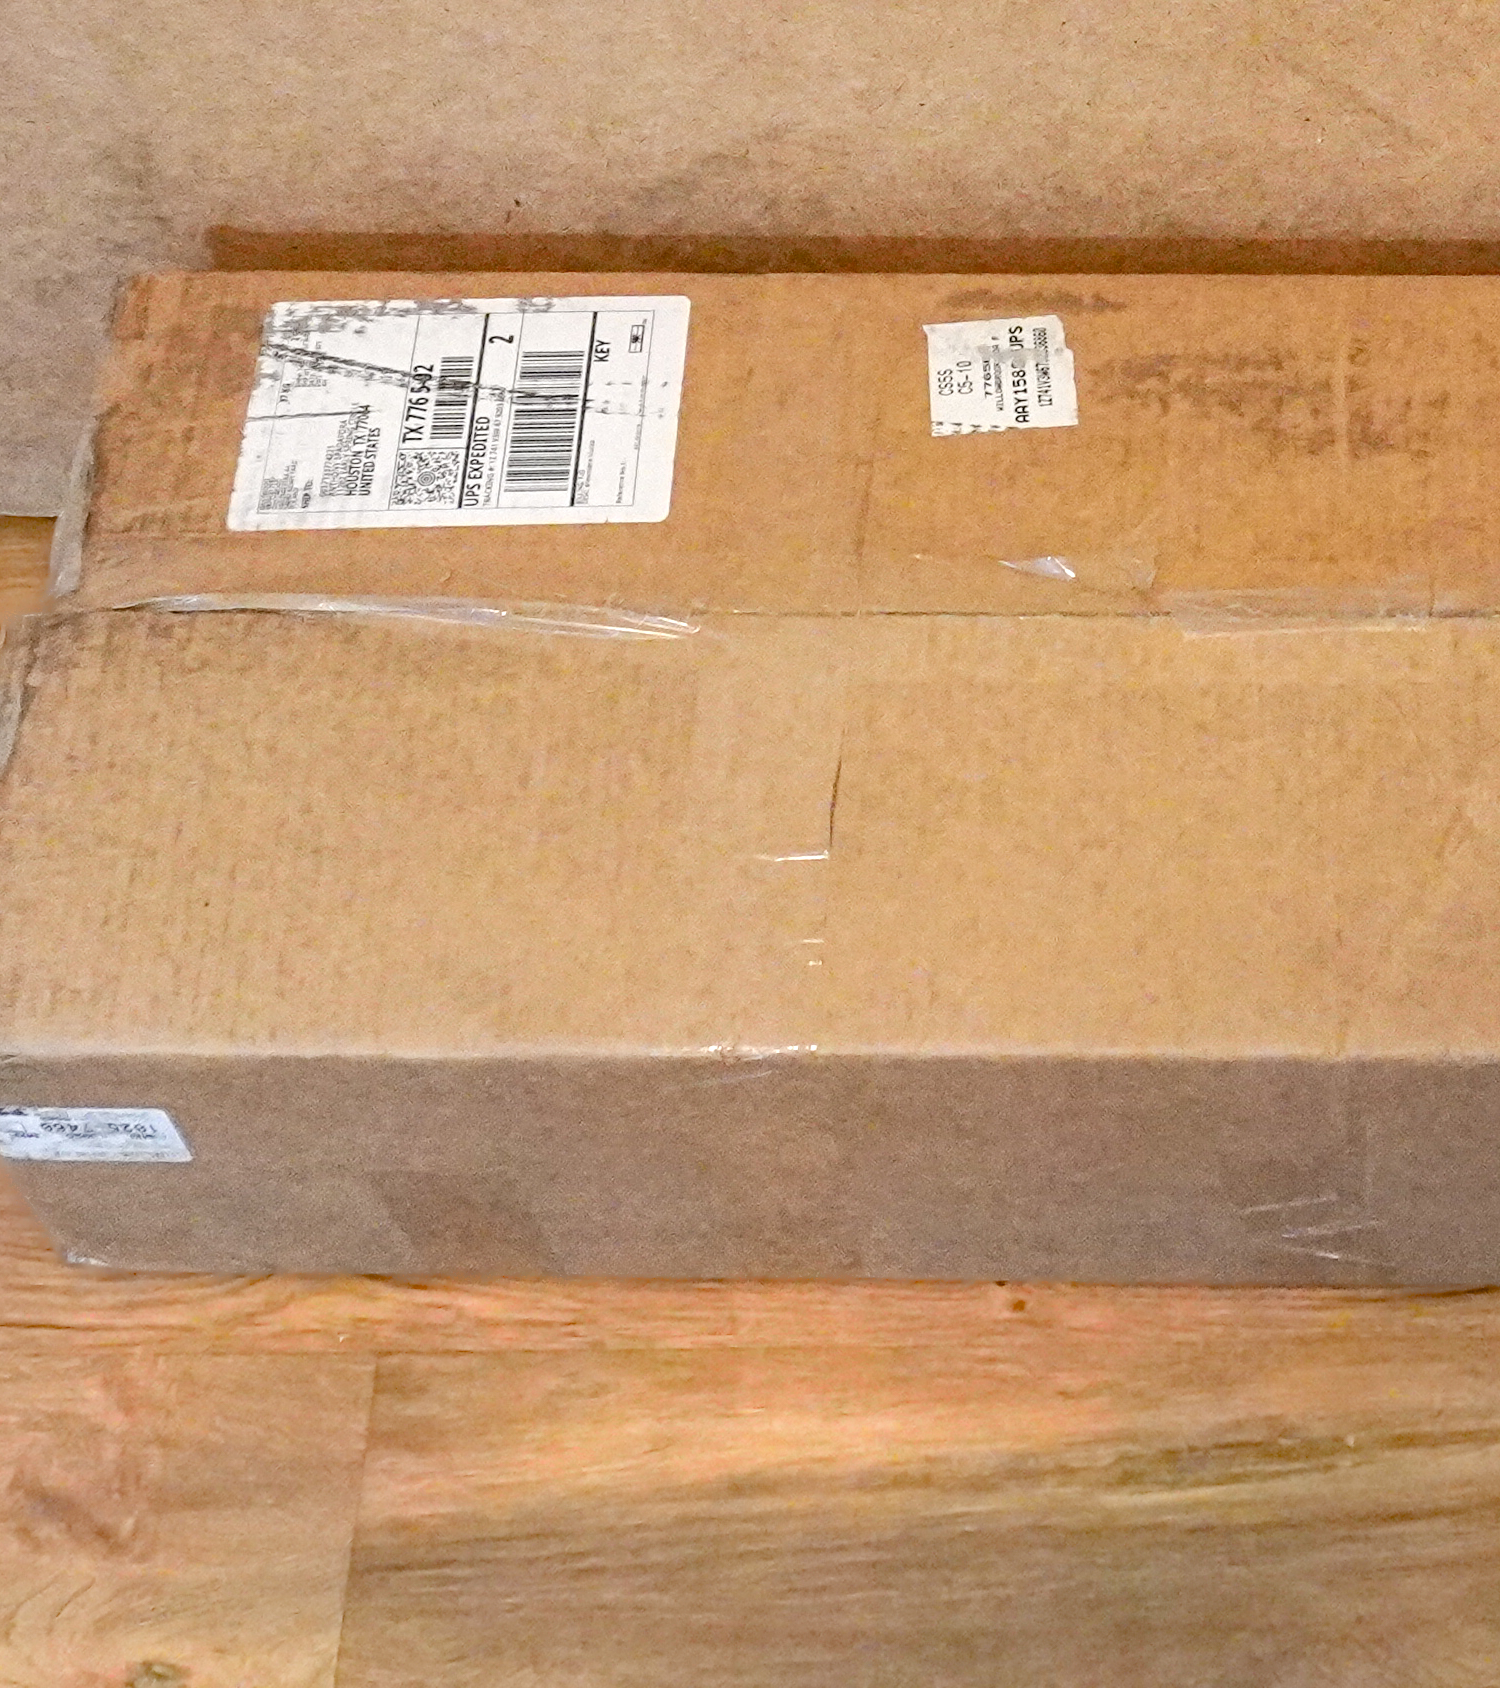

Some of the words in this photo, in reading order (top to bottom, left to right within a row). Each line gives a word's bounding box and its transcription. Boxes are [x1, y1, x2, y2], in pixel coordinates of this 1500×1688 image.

[488, 334, 514, 343] 2
[593, 339, 611, 362] KEY
[409, 364, 434, 393] 5-02
[1011, 362, 1030, 423] AAY158
[405, 397, 429, 421] 776
[352, 434, 366, 445] TX
[364, 427, 381, 458] STATES
[402, 426, 424, 442] TX
[467, 416, 490, 479] EXPEDITED
[344, 450, 363, 495] HOUSTON
[358, 460, 375, 495] UNITED
[463, 483, 481, 506] UPS
